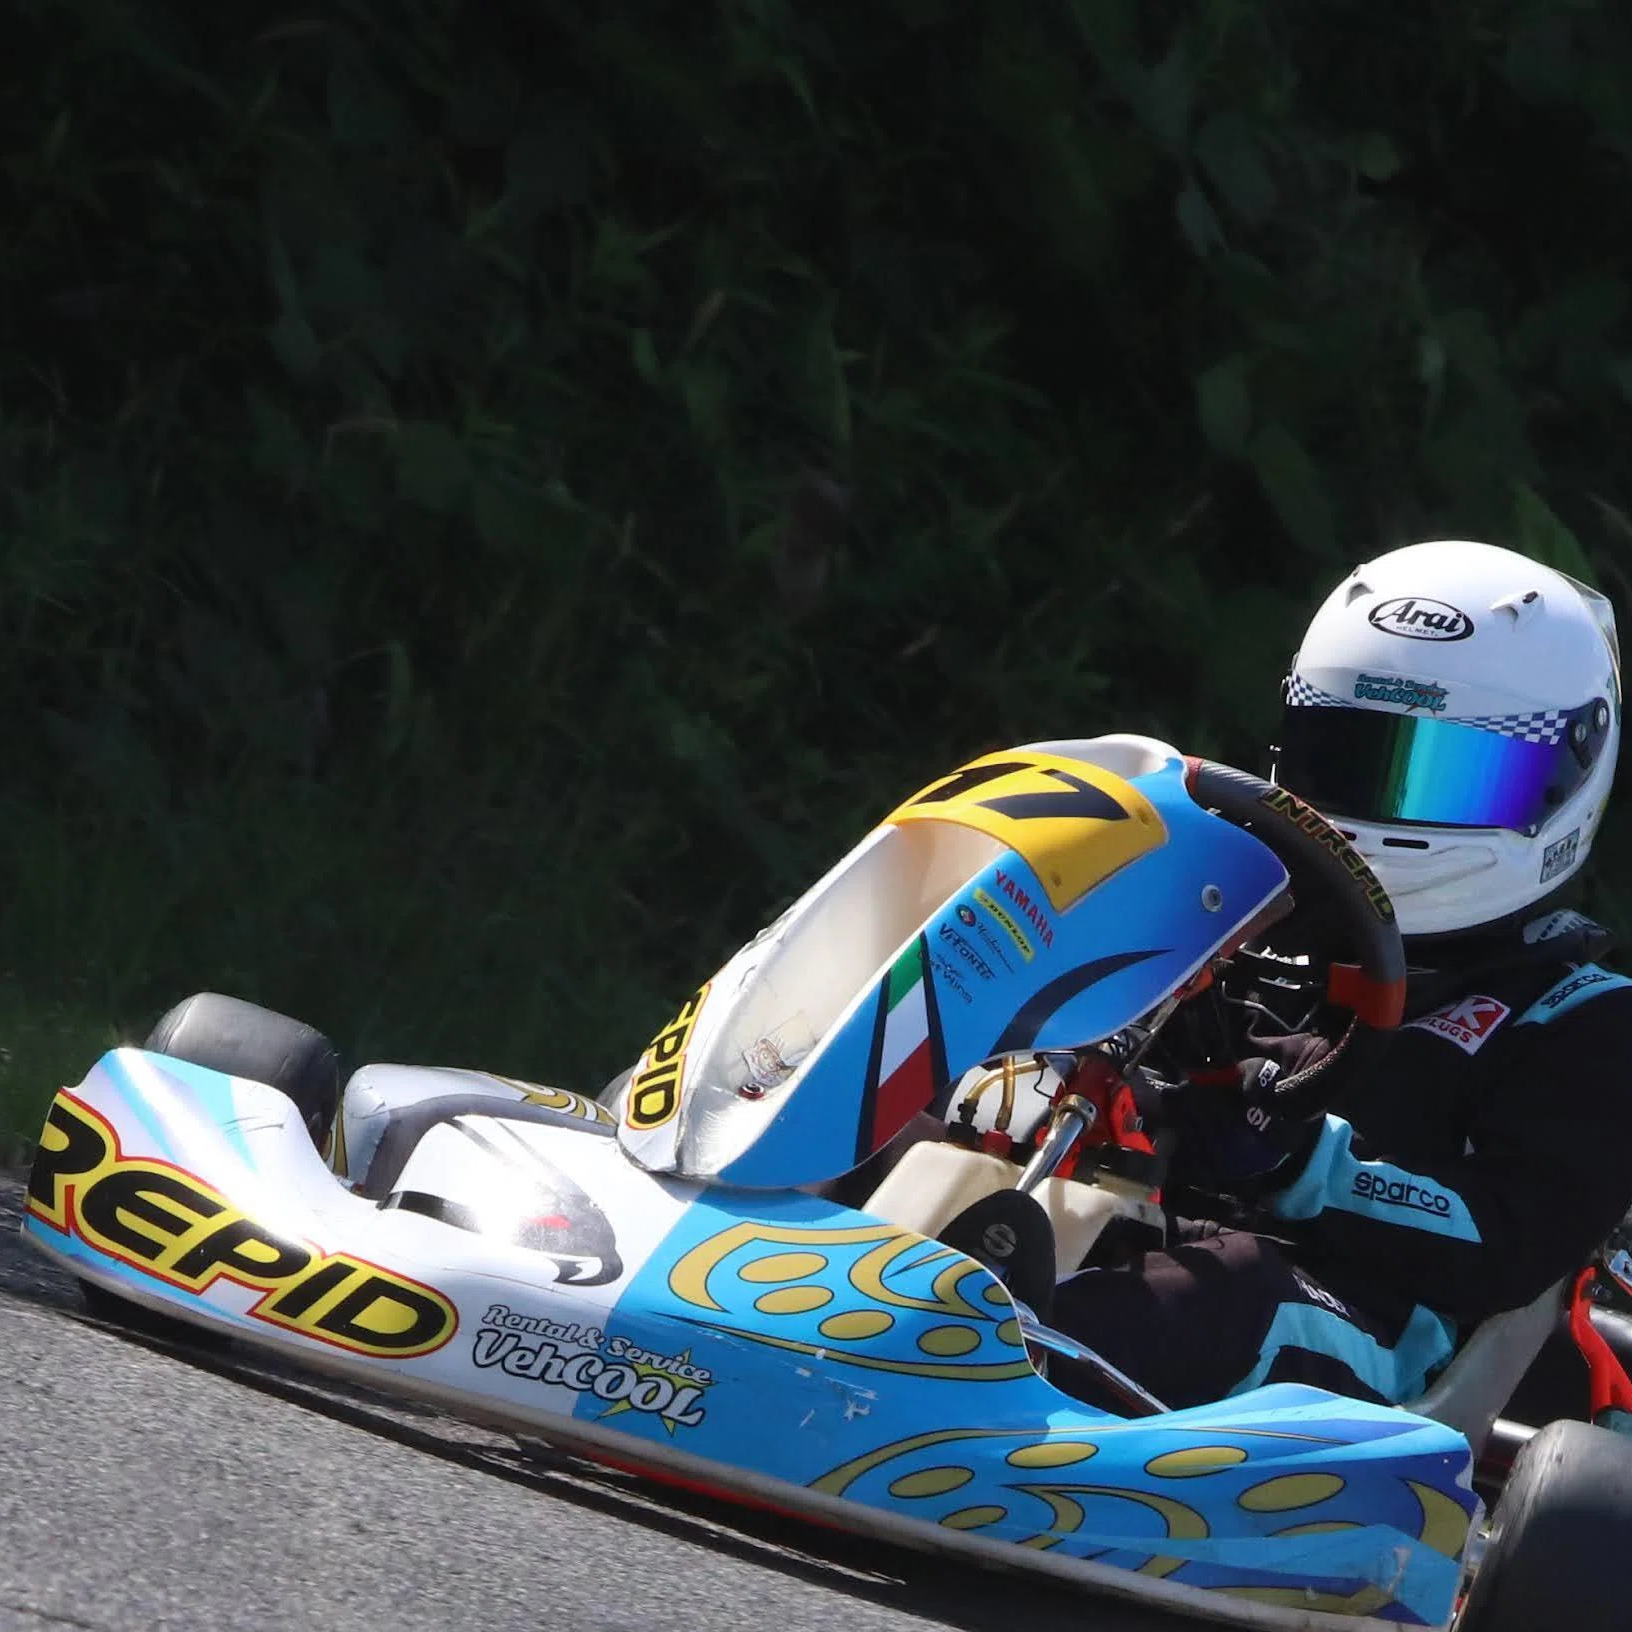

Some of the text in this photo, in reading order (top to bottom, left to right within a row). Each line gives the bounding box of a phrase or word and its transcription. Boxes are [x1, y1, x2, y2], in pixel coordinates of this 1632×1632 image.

[1373, 600, 1464, 633] Arai
[995, 868, 1054, 949] YAMAHA
[1351, 1171, 1451, 1217] sparco
[472, 1328, 707, 1427] VehCOOL
[481, 1304, 713, 1386] Rental & Service
